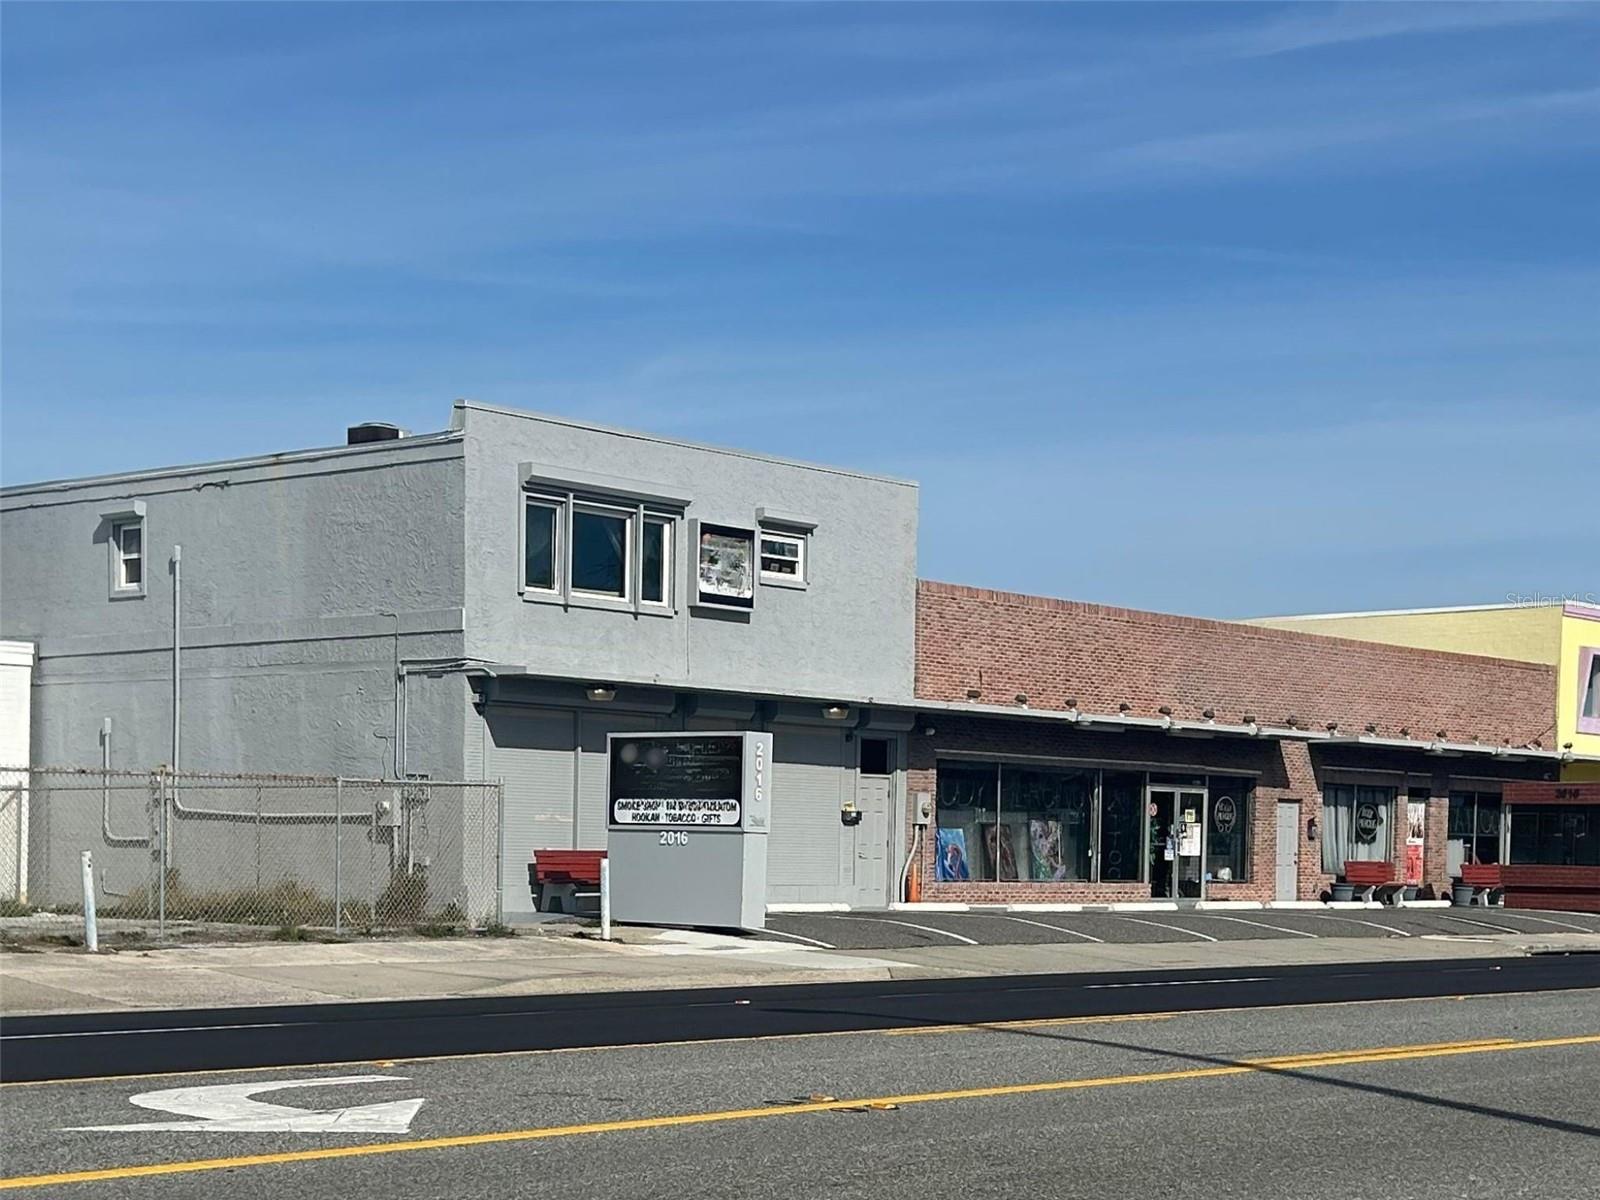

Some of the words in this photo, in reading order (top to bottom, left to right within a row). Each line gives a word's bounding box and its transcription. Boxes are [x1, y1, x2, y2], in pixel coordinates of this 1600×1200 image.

[755, 742, 764, 801] 2016
[631, 813, 660, 823] HOOKAH
[665, 813, 697, 823] TOBACCO
[702, 814, 721, 824] GIFTS
[659, 831, 689, 846] 2016
